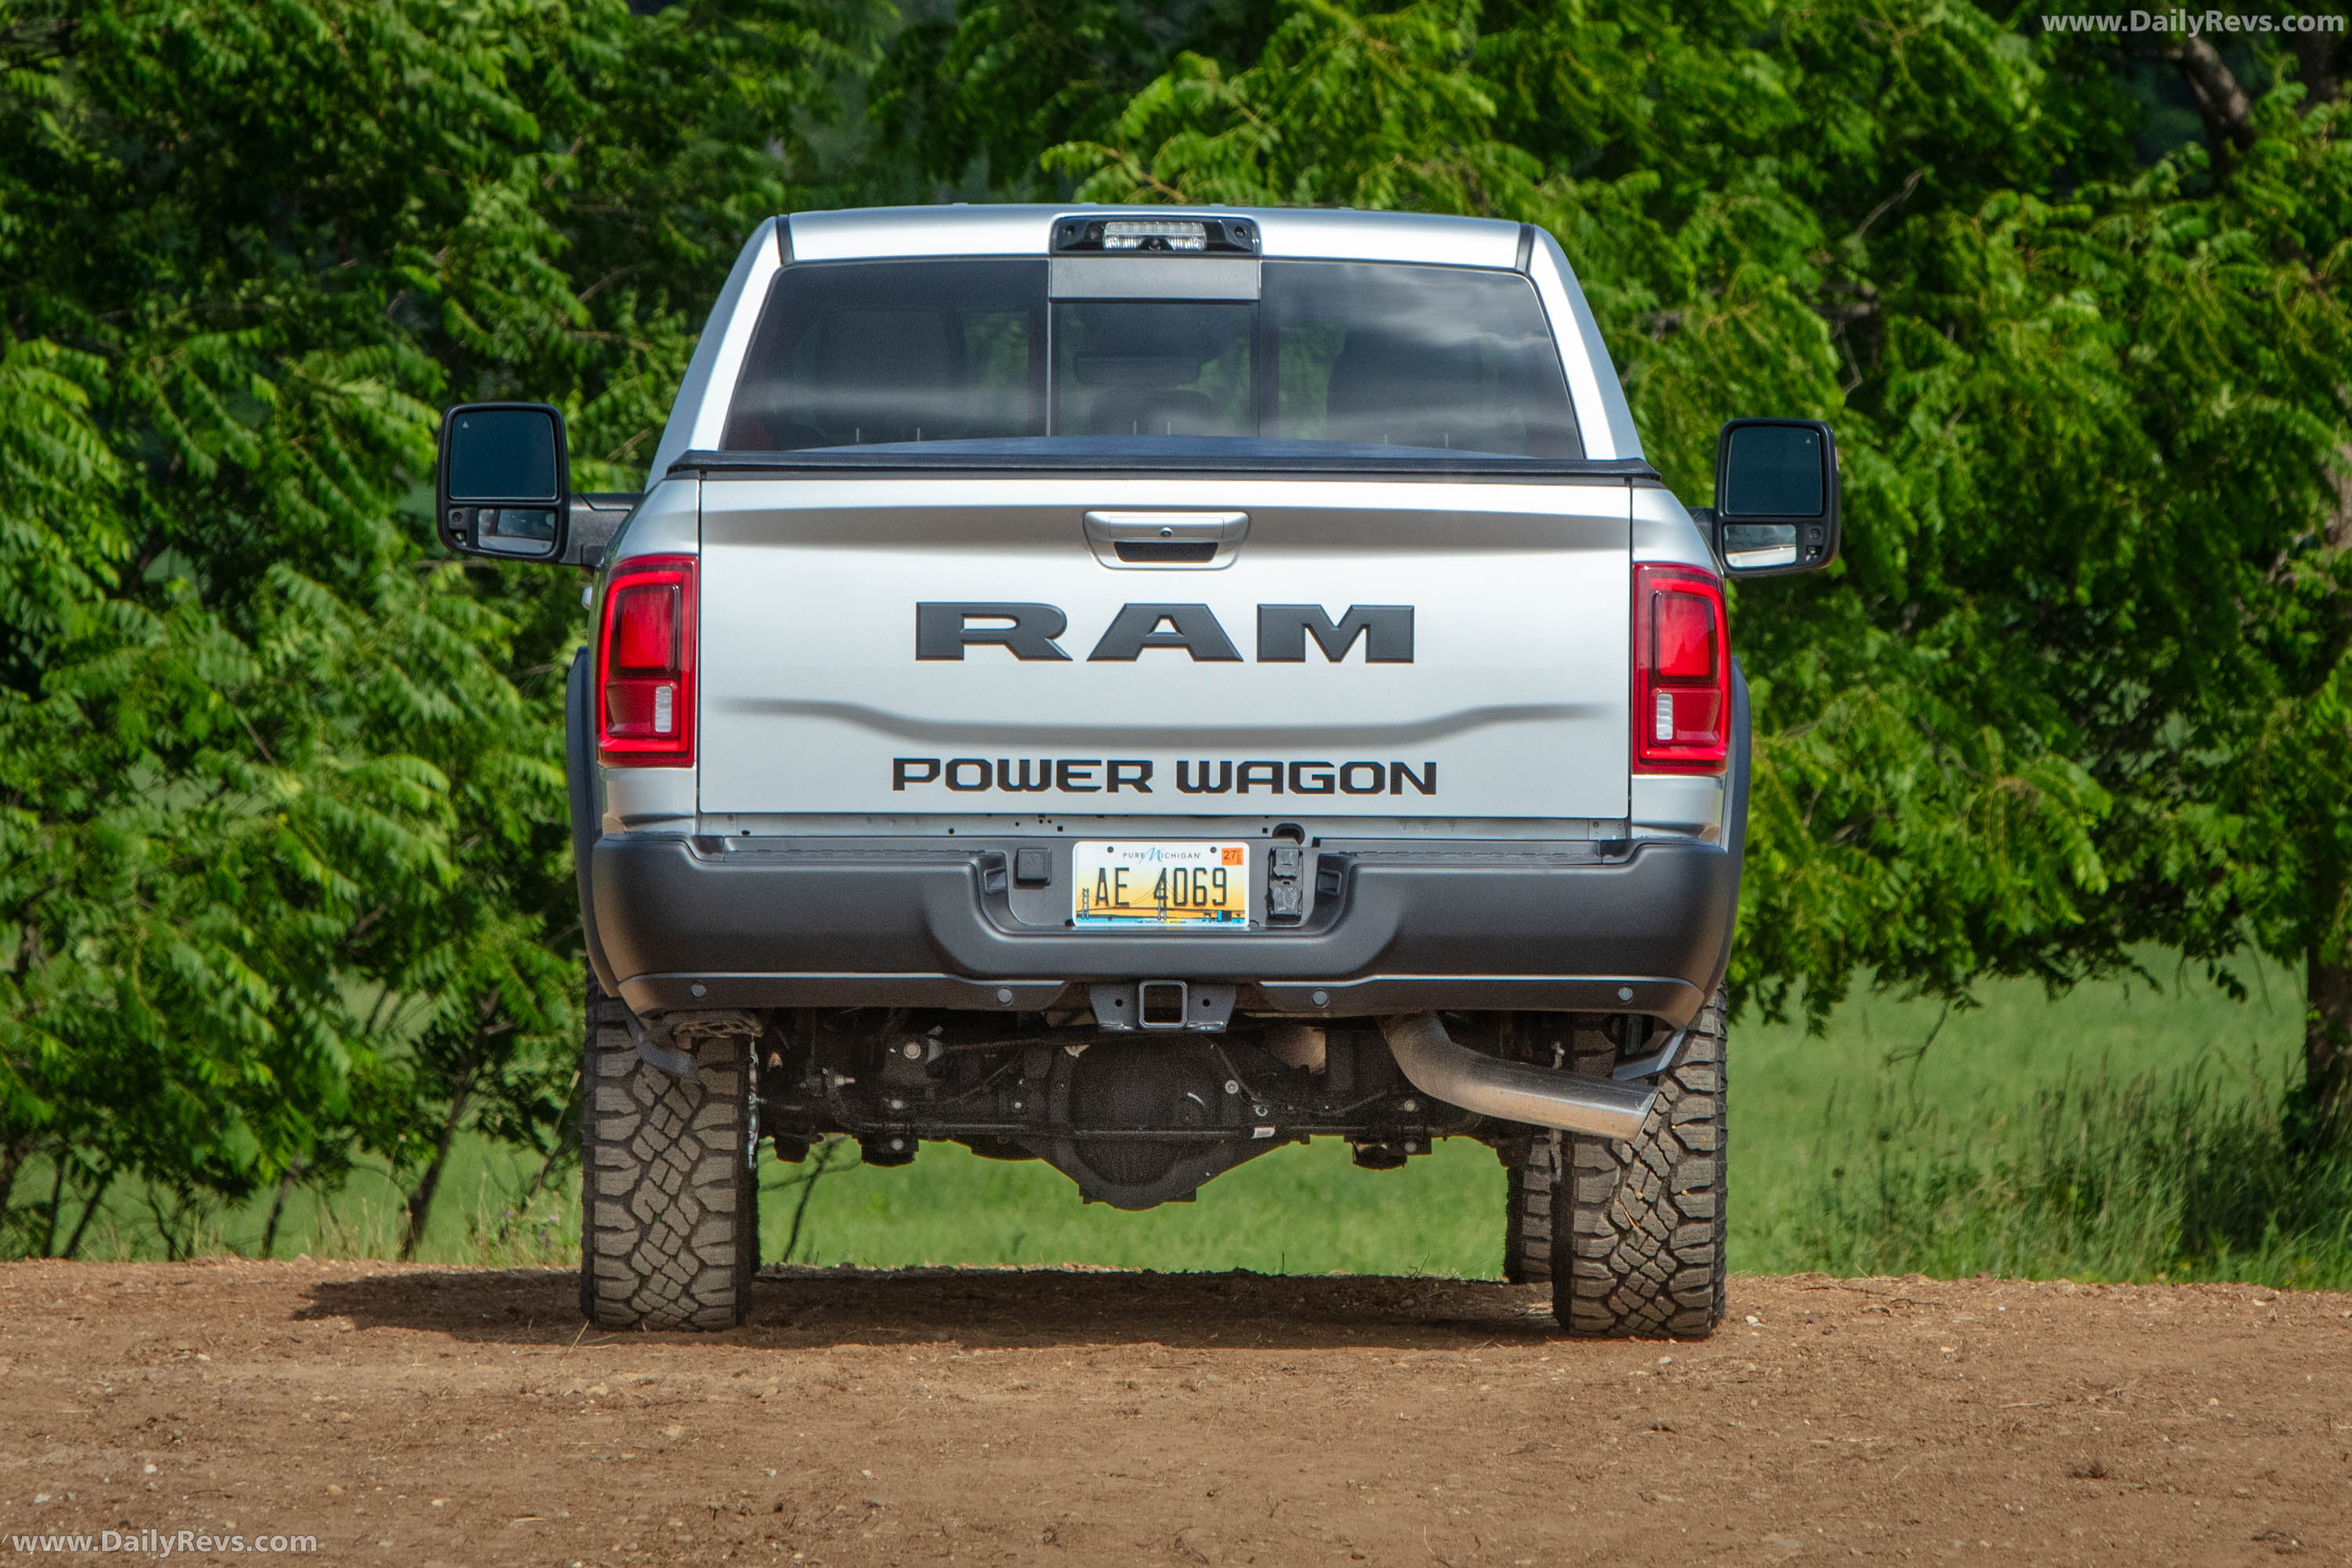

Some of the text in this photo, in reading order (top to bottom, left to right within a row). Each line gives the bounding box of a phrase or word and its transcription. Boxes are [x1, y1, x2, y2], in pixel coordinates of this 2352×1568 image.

[916, 601, 1415, 663] RAM
[892, 758, 1437, 796] POWER WAGON
[1223, 850, 1237, 860] 27
[1095, 867, 1227, 906] AE 4069
